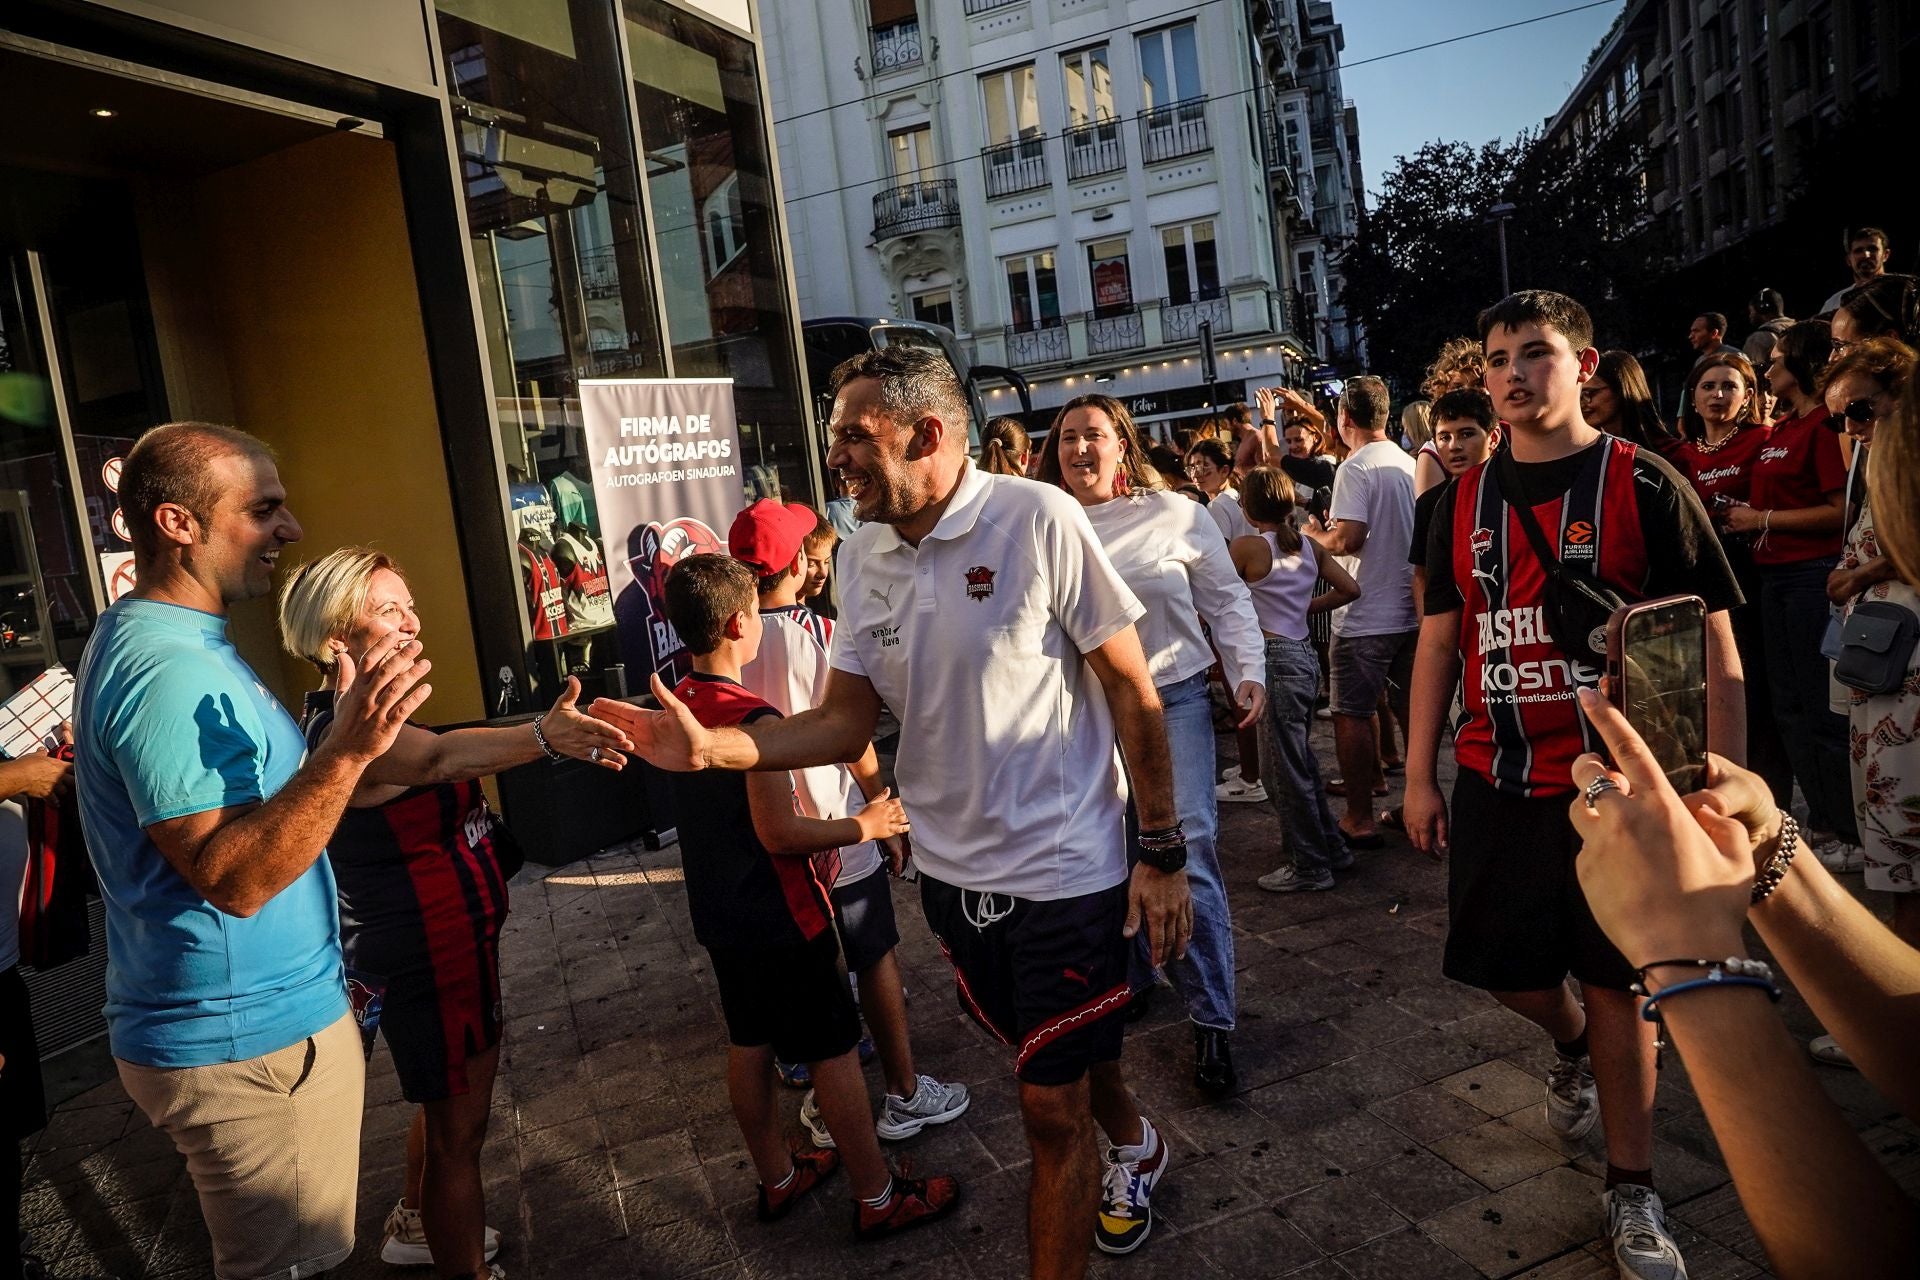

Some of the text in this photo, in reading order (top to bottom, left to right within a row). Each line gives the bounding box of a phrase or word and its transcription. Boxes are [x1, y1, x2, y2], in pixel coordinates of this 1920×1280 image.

[620, 414, 711, 437] FIRMA DE
[603, 439, 731, 467] AUTÓGRAFOS
[605, 465, 736, 489] AUTOGRAFOEN SINADURA
[653, 618, 687, 660] BA
[1505, 691, 1575, 704] Climatización
